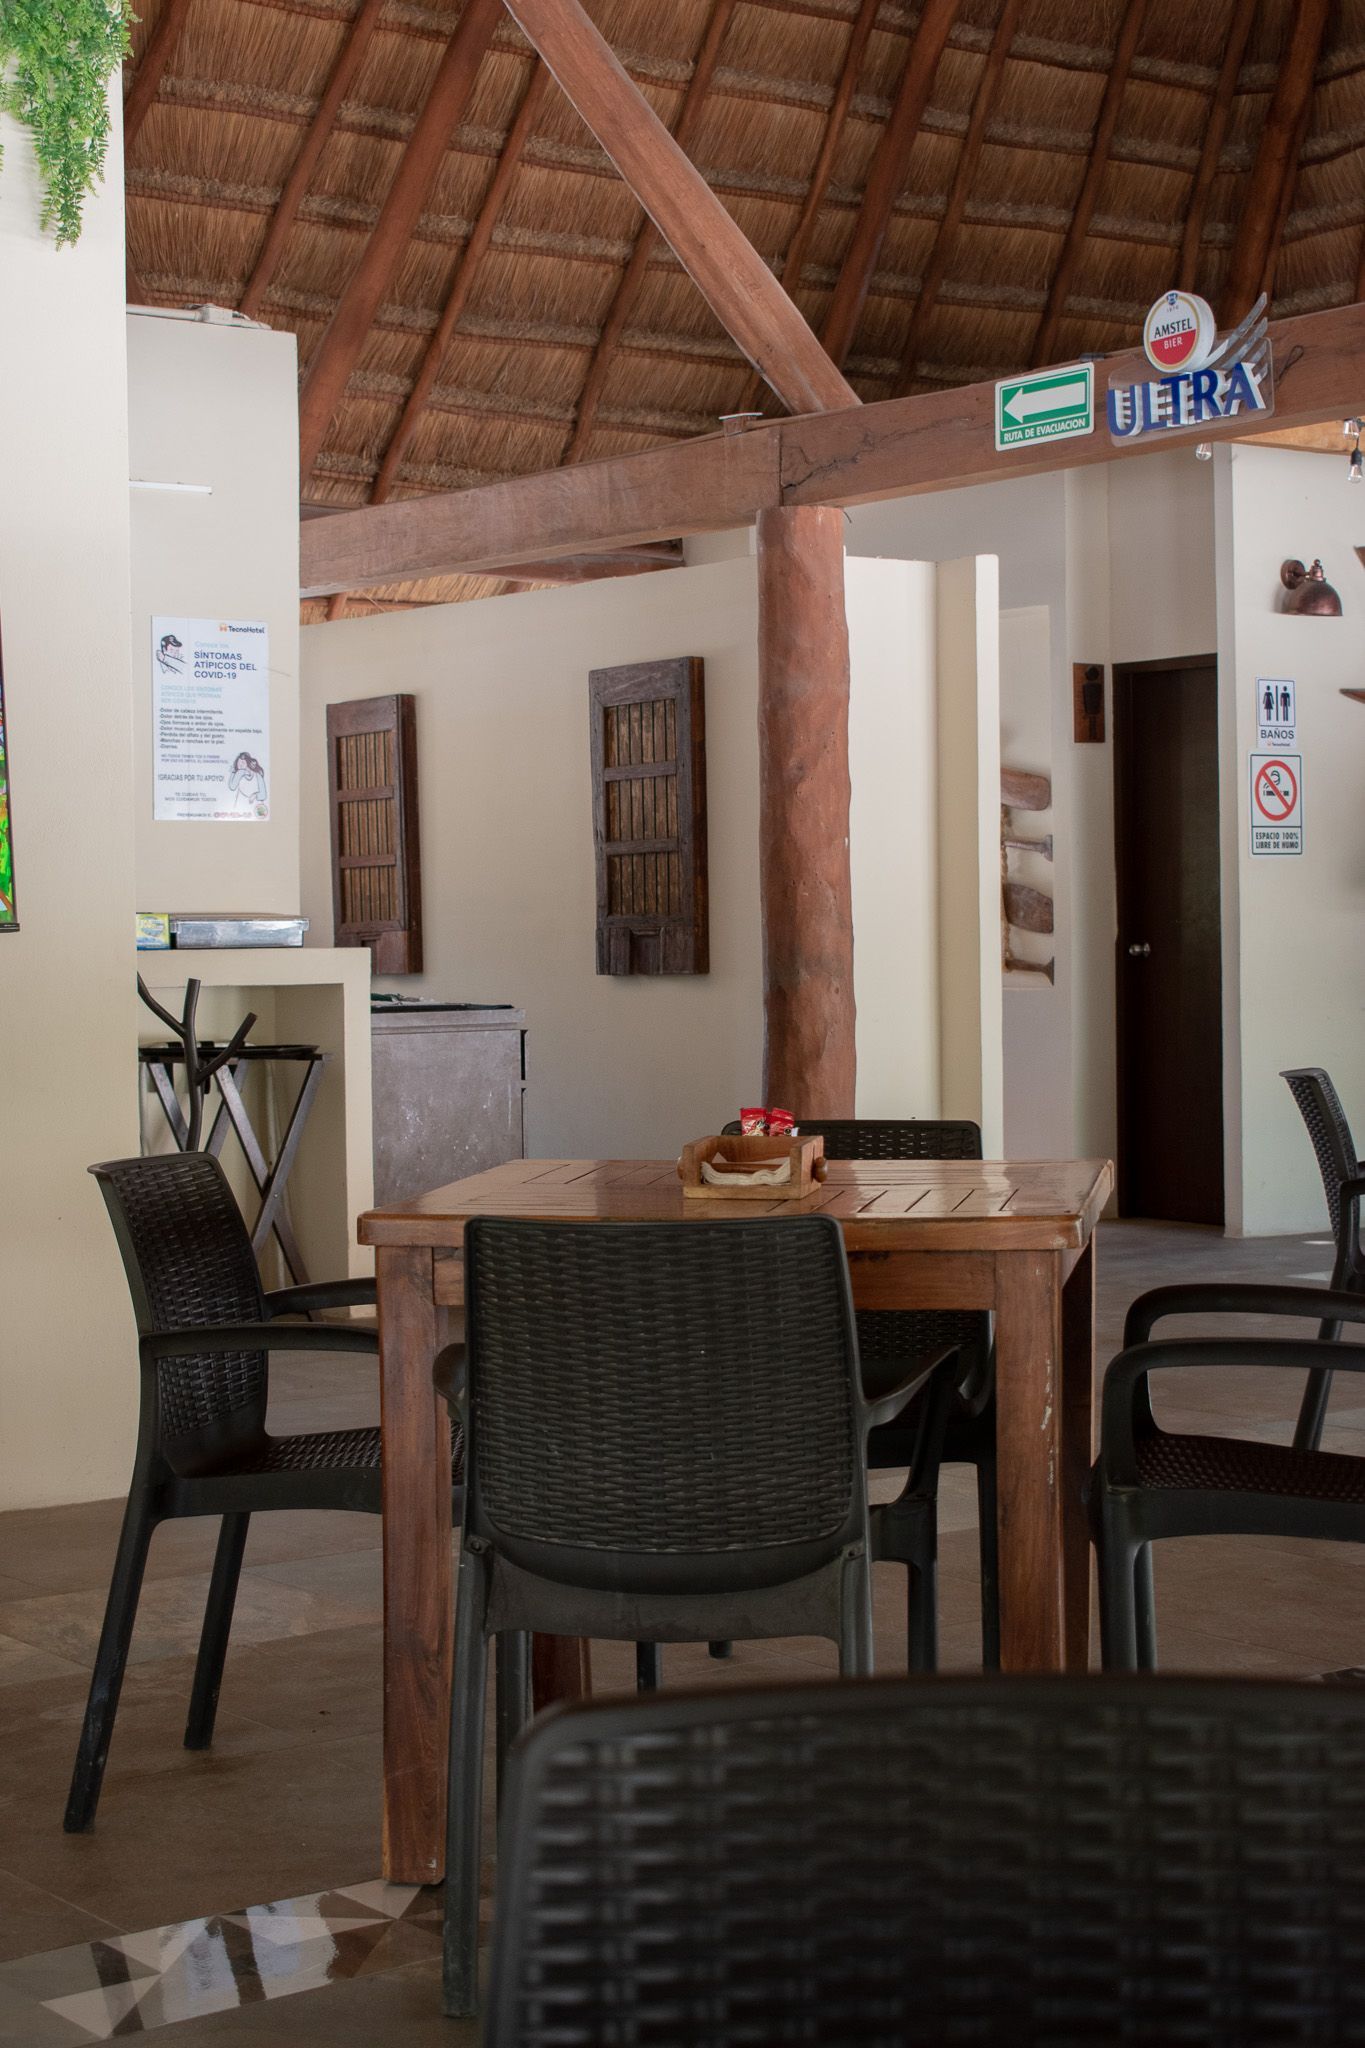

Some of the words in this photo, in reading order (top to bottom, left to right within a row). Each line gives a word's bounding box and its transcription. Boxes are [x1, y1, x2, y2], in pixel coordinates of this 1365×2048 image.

[1154, 317, 1192, 339] AMSTEL
[1164, 337, 1183, 350] BIER
[1106, 362, 1266, 437] ULTRA
[1003, 430, 1023, 442] RUTA
[1024, 428, 1035, 438] DE
[228, 625, 265, 634] TecnoHotel
[194, 650, 242, 660] SÍNTOMAS
[194, 660, 237, 670] ATÍPICOS
[239, 663, 257, 671] DEL
[194, 670, 237, 679] COVID-19
[1260, 728, 1295, 740] BAÑOS
[1255, 832, 1280, 840] ESPACIO
[1282, 832, 1298, 840] 100%
[1255, 841, 1271, 849] LIBRE
[1273, 841, 1280, 849] DE
[1282, 841, 1298, 849] HUMO
